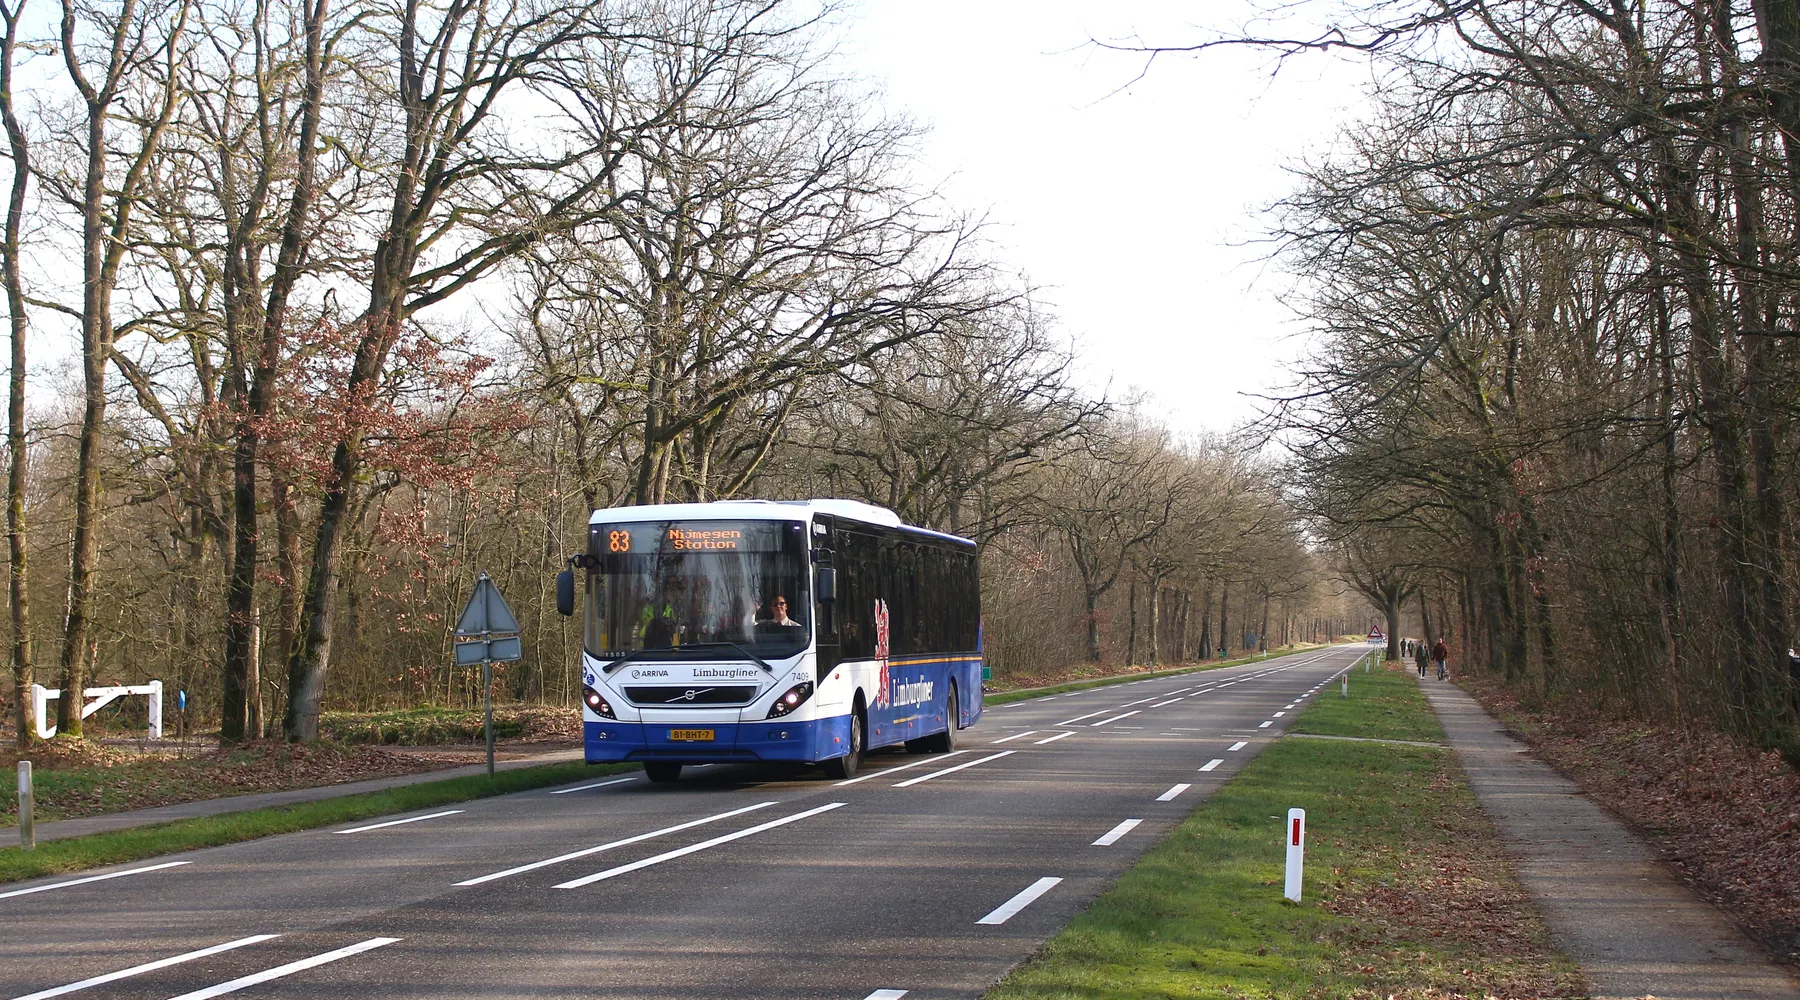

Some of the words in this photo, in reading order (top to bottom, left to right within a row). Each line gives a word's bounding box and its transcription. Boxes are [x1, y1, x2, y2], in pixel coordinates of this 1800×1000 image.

[669, 529, 741, 540] Nijmegen
[609, 530, 630, 552] 83
[674, 540, 736, 550] Station
[693, 668, 758, 678] Limburgliner
[791, 672, 809, 681] 7409
[893, 675, 934, 709] Limburgliner
[673, 731, 710, 739] 81-BHT-7
